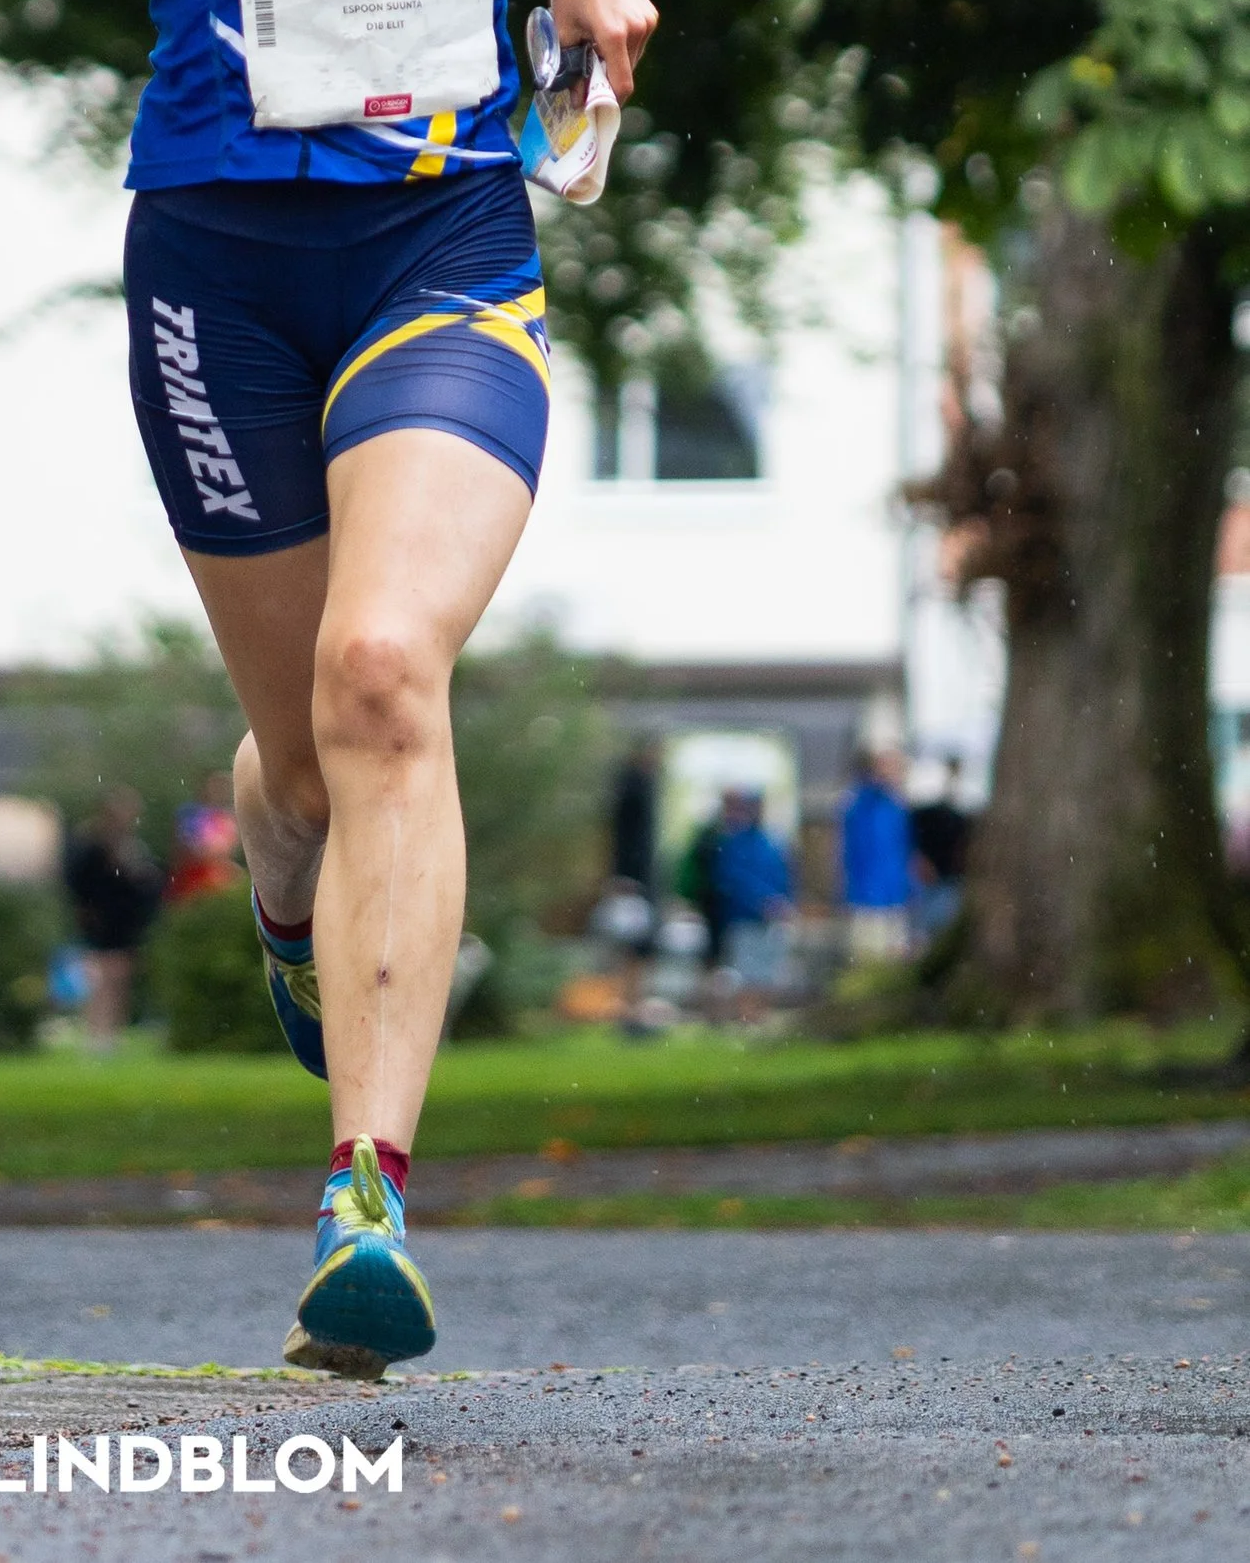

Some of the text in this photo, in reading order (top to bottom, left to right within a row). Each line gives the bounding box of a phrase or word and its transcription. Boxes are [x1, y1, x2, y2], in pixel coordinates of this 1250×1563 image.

[343, 0, 423, 14] ESPOON SUUNTA
[386, 20, 405, 30] ELIT
[152, 296, 261, 521] TRIMTEX
